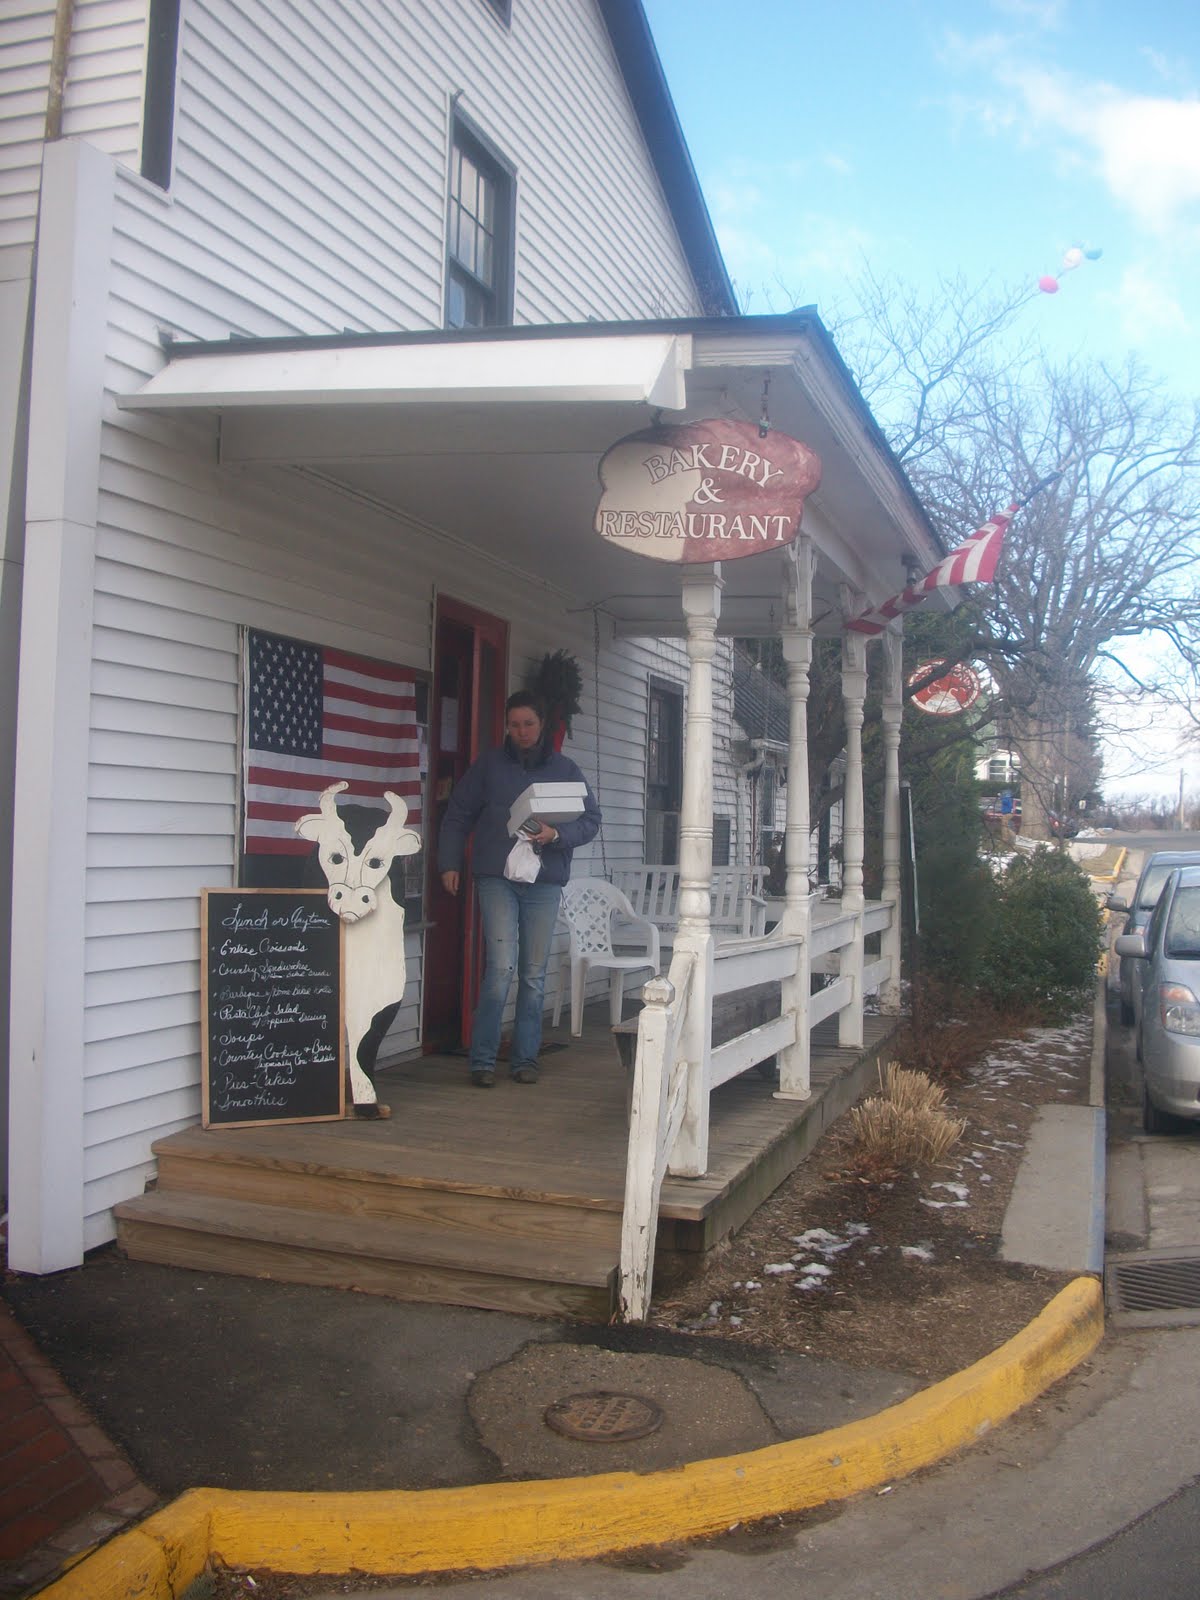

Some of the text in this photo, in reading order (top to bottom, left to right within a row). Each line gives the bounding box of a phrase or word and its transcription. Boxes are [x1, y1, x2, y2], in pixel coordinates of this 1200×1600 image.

[642, 443, 784, 488] BAKERY
[692, 477, 726, 504] &
[599, 509, 792, 541] RESTAURANT
[222, 903, 268, 933] Lunch
[272, 916, 289, 927] or
[219, 962, 259, 982] Country
[219, 1003, 248, 1020] Pasta
[273, 1002, 302, 1016] Salad
[219, 1028, 264, 1049] Soups
[219, 1049, 263, 1067] Country
[264, 1042, 303, 1059] Cookies
[311, 1038, 333, 1054] Bars
[218, 1089, 288, 1111] Smoothies
